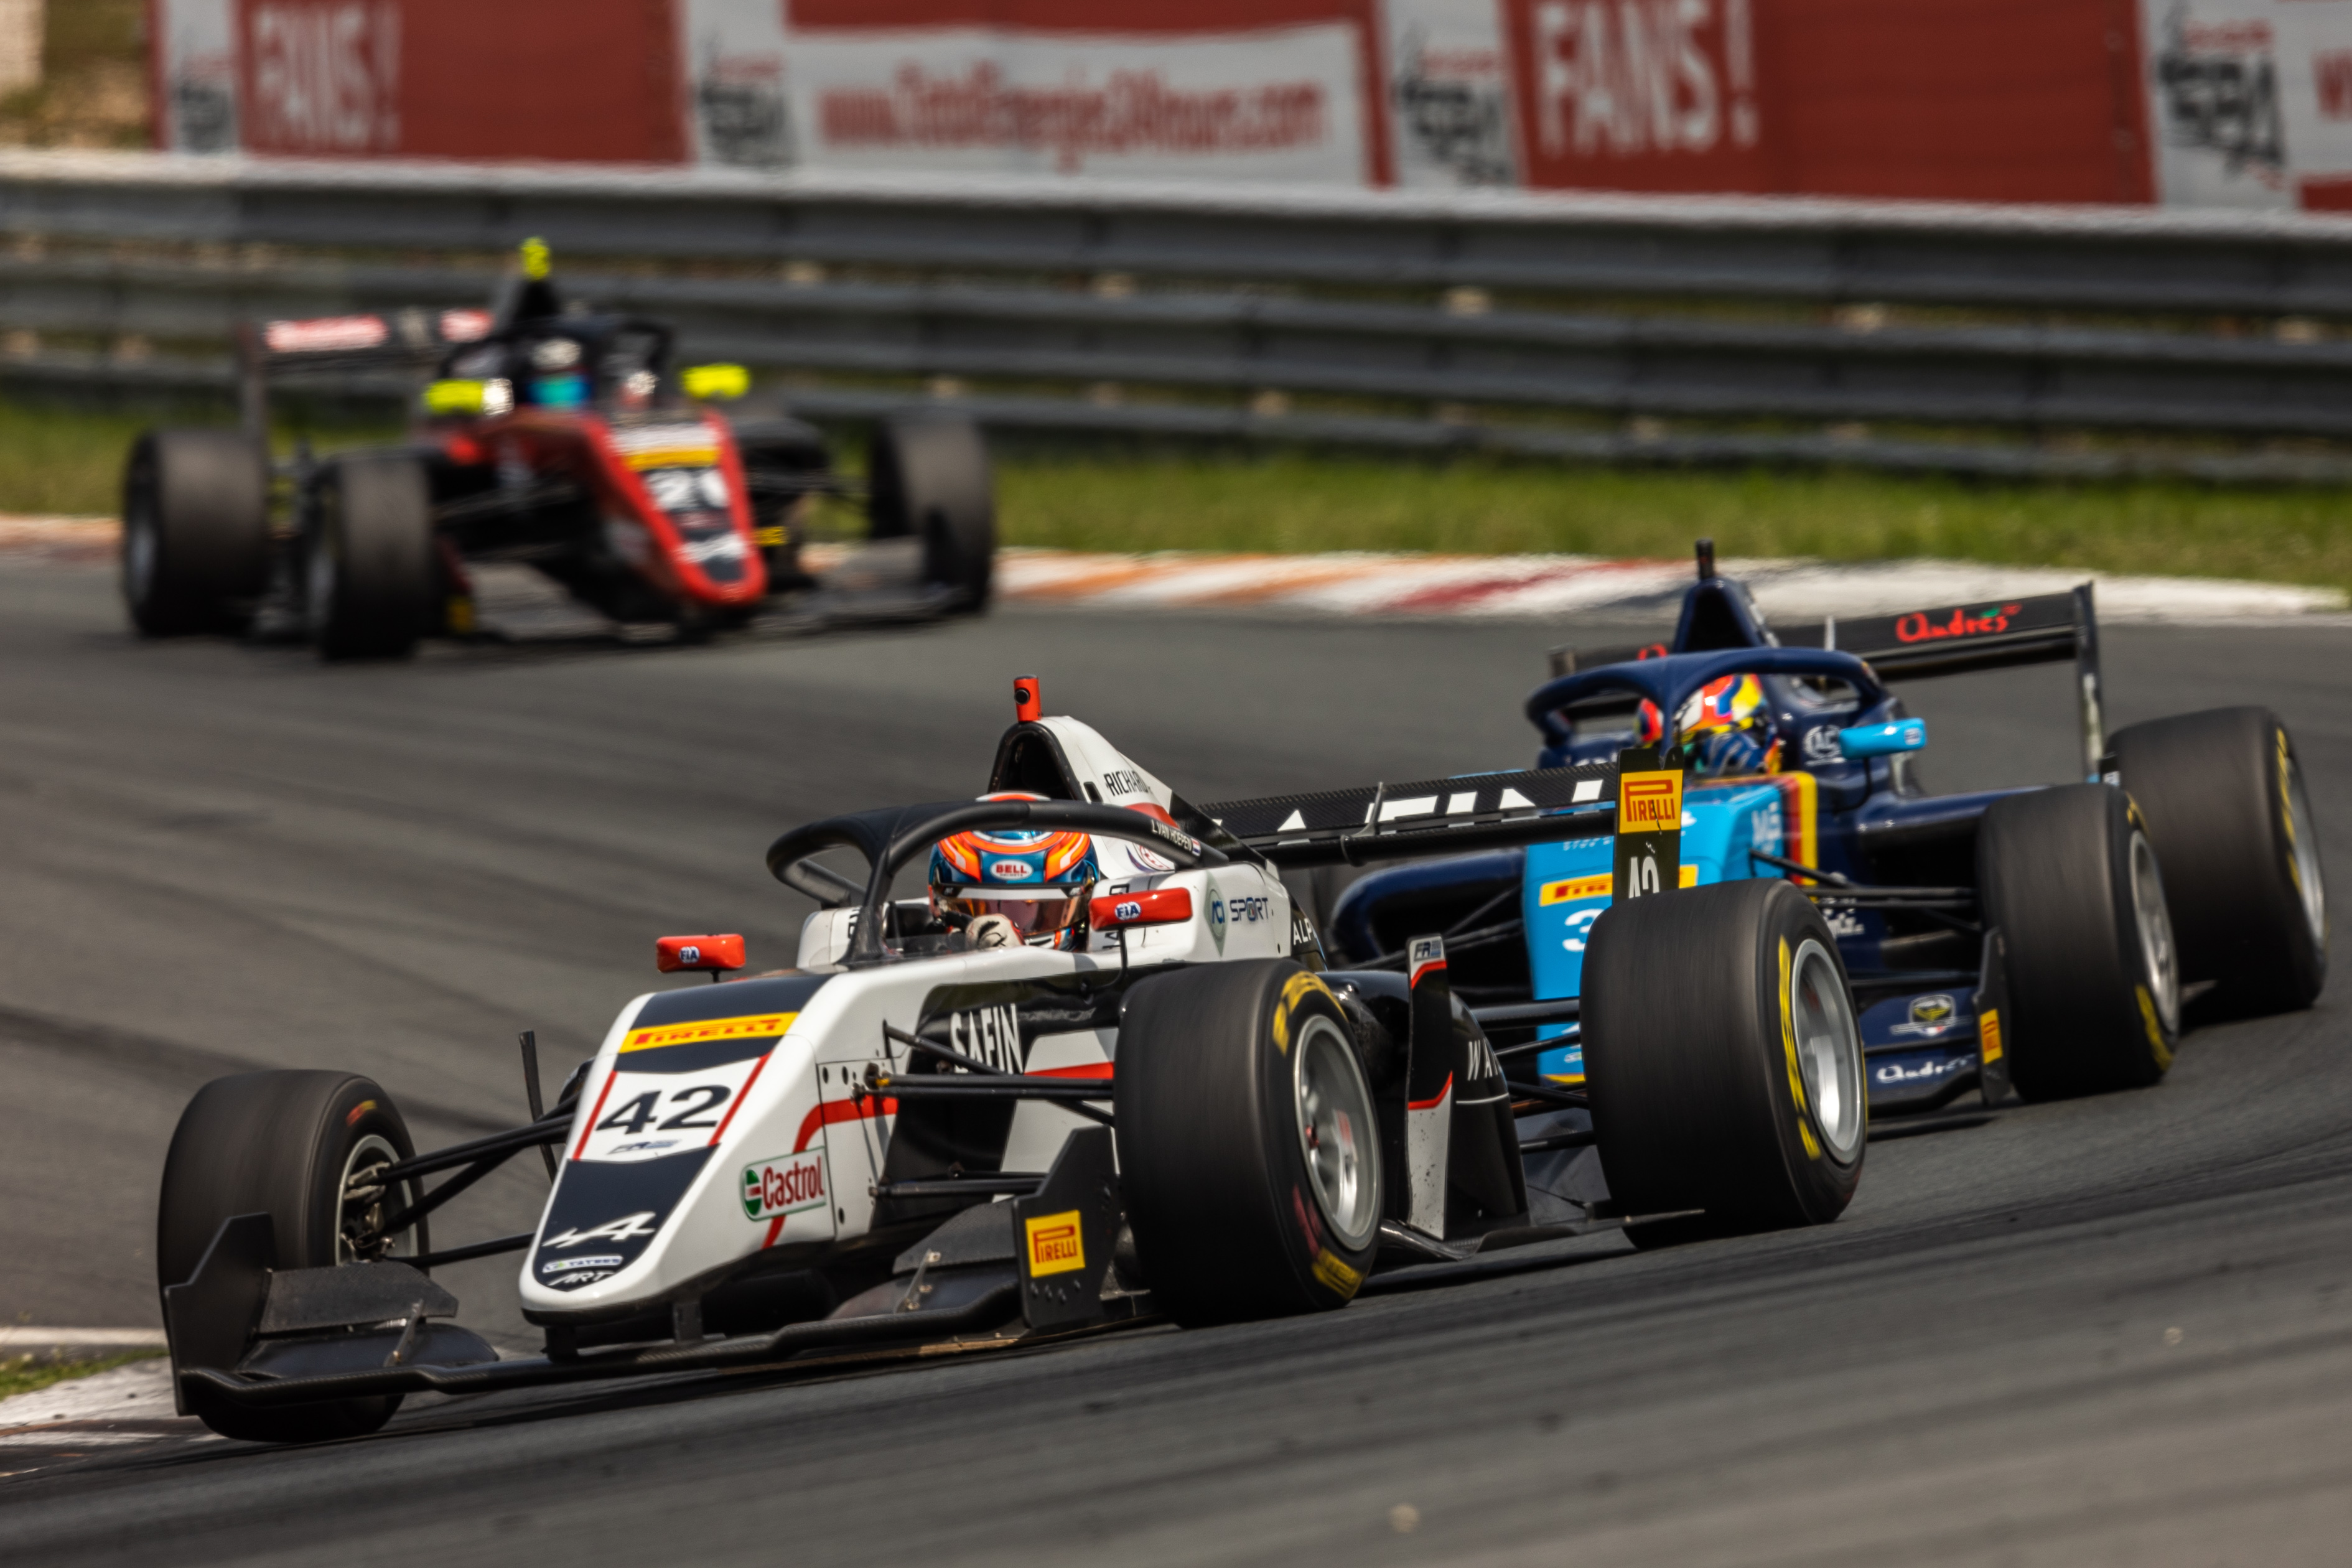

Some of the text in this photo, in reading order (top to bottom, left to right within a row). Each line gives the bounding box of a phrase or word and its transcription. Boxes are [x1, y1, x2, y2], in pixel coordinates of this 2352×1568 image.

[1537, 0, 1760, 157] FANS!
[1103, 769, 1149, 796] RICHARD
[1623, 779, 1675, 823] PIRELLI
[996, 864, 1027, 874] BELL
[1230, 897, 1269, 922] SPORT
[1293, 918, 1317, 946] ALP
[951, 1003, 1024, 1075] SAFIN
[595, 1085, 732, 1135] 42
[762, 1155, 824, 1210] Castrol
[1033, 1224, 1078, 1264] PIRELLI
